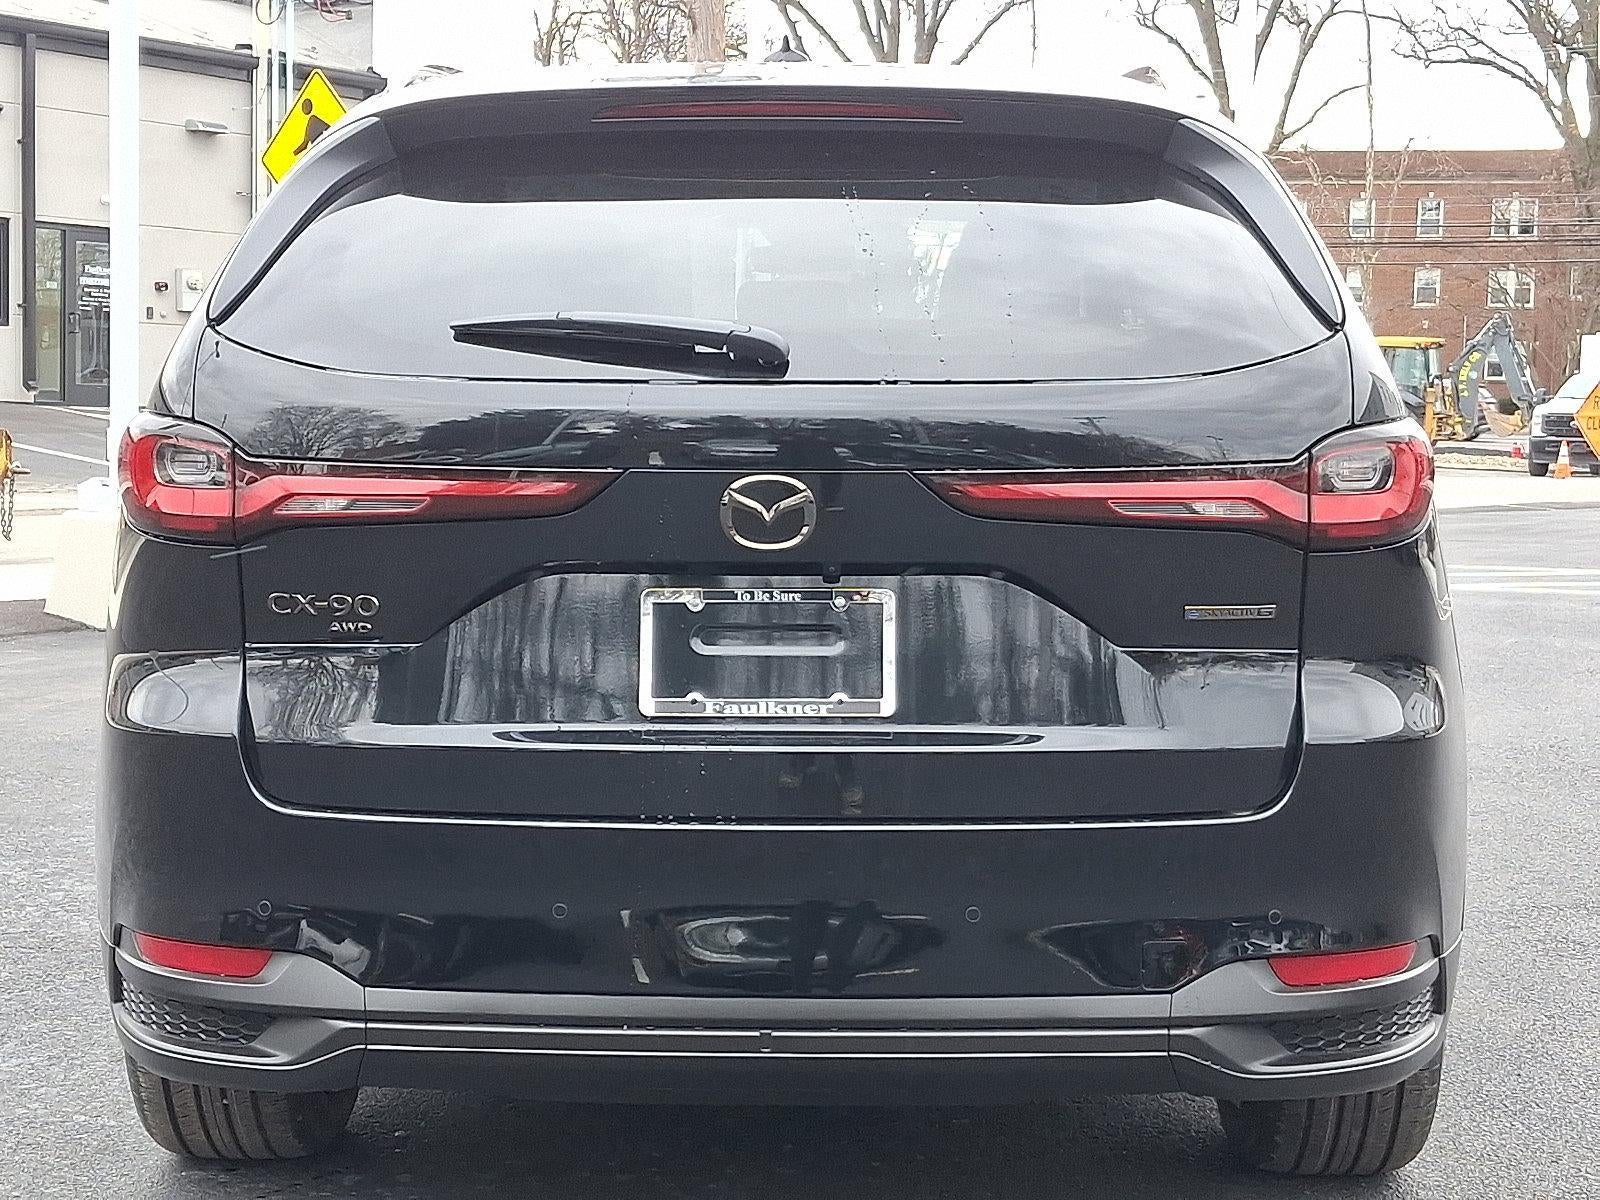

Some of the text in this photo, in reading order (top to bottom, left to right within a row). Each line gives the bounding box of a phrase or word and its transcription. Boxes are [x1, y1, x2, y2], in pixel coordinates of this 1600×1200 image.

[734, 590, 802, 601] To Be Sure
[267, 592, 380, 616] CX-90
[329, 621, 372, 633] AWD
[703, 700, 834, 715] Faulkner
